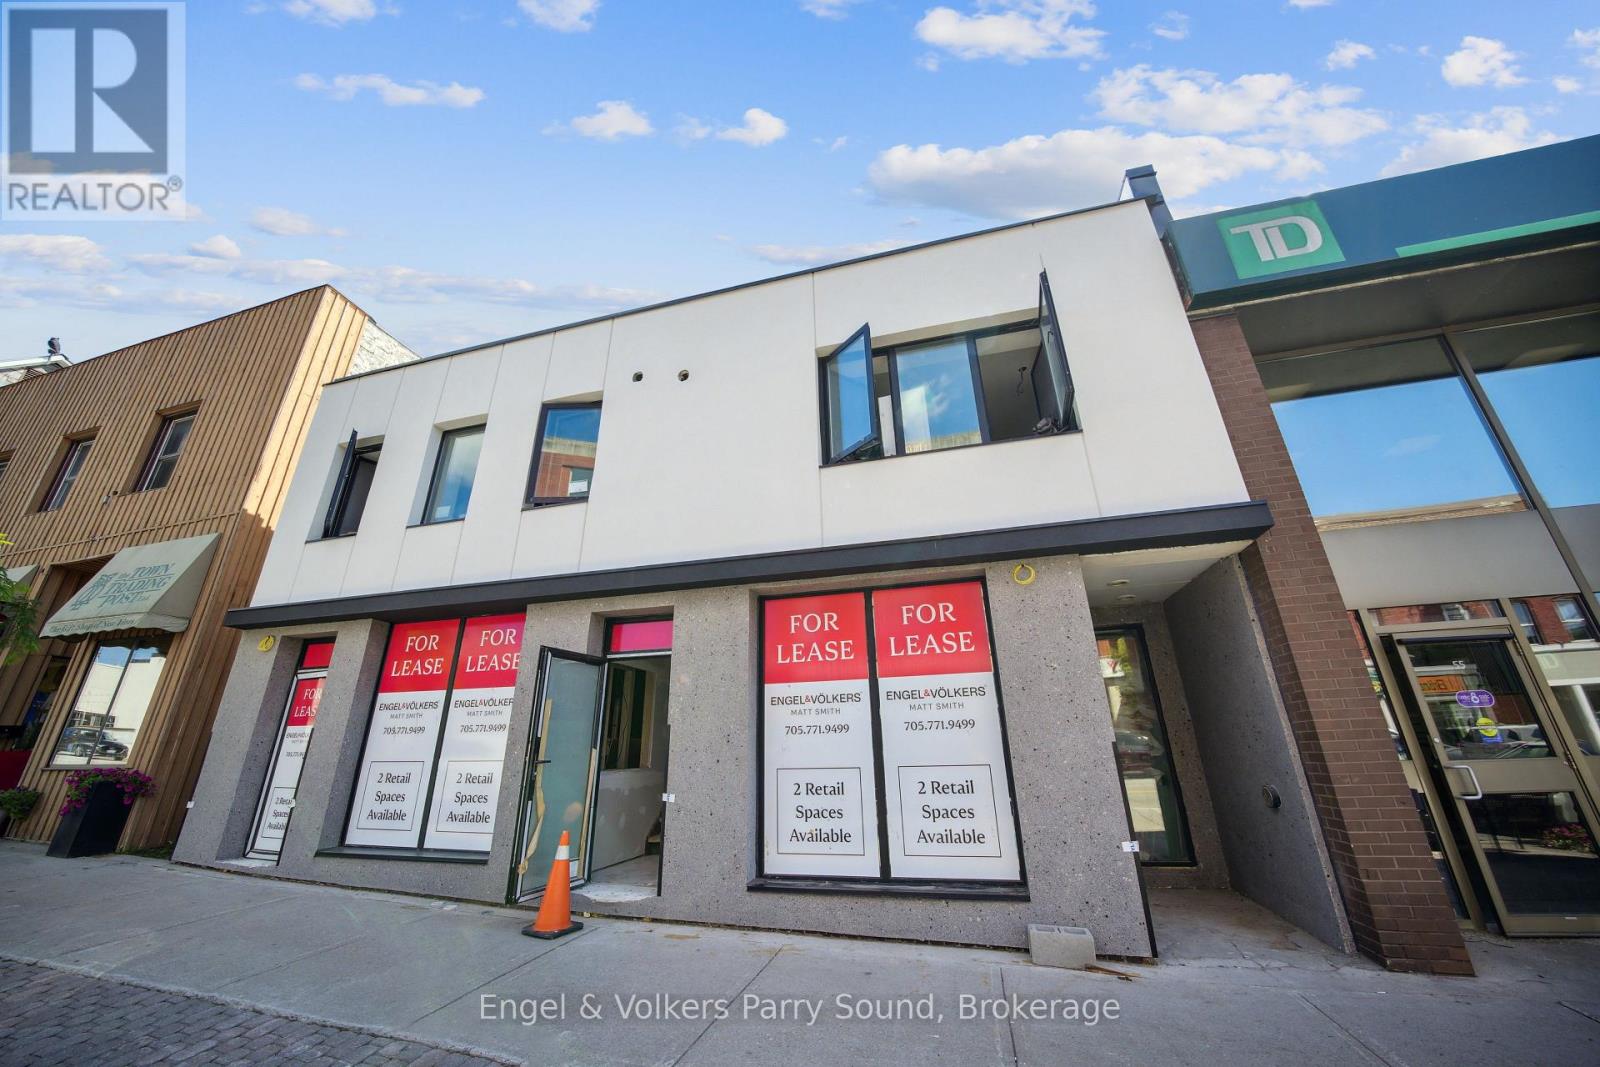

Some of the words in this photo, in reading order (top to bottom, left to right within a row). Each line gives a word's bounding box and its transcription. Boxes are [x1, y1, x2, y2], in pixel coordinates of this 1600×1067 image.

[1230, 215, 1323, 262] TD
[129, 563, 174, 577] TOWN
[105, 577, 171, 594] TRADING
[901, 602, 957, 625] FOR
[789, 612, 840, 634] FOR
[405, 634, 440, 652] FOR
[479, 628, 517, 647] FOR
[888, 631, 976, 657] LEASE
[776, 639, 855, 665] LEASE
[391, 658, 444, 677] LEASE
[1452, 660, 1466, 670] 55
[454, 698, 514, 709] ENGEL&VÖLKER
[909, 703, 933, 712] MATT
[935, 701, 965, 711] SMITH
[294, 705, 317, 717] LEAS
[790, 708, 813, 716] MATT
[815, 707, 841, 716] SMITH
[383, 726, 426, 735] 705.771.9499
[460, 724, 507, 733] 705.771.9499
[784, 723, 850, 736] 705.771.9499
[903, 718, 976, 732] 705.771.9499
[377, 773, 384, 783] 2
[385, 772, 411, 784] Retail
[456, 773, 463, 784] 2
[464, 772, 494, 784] Retail
[793, 782, 801, 796] 2
[805, 782, 845, 796] Retail
[917, 781, 927, 794] 2
[930, 780, 975, 795] Retail
[374, 791, 406, 804] Spaces
[454, 792, 488, 804] Spaces
[366, 809, 407, 821] Available
[446, 810, 491, 824] Available
[795, 805, 844, 821] Spaces
[922, 804, 975, 821] Spaces
[789, 828, 852, 844] Available
[917, 828, 986, 845] Available
